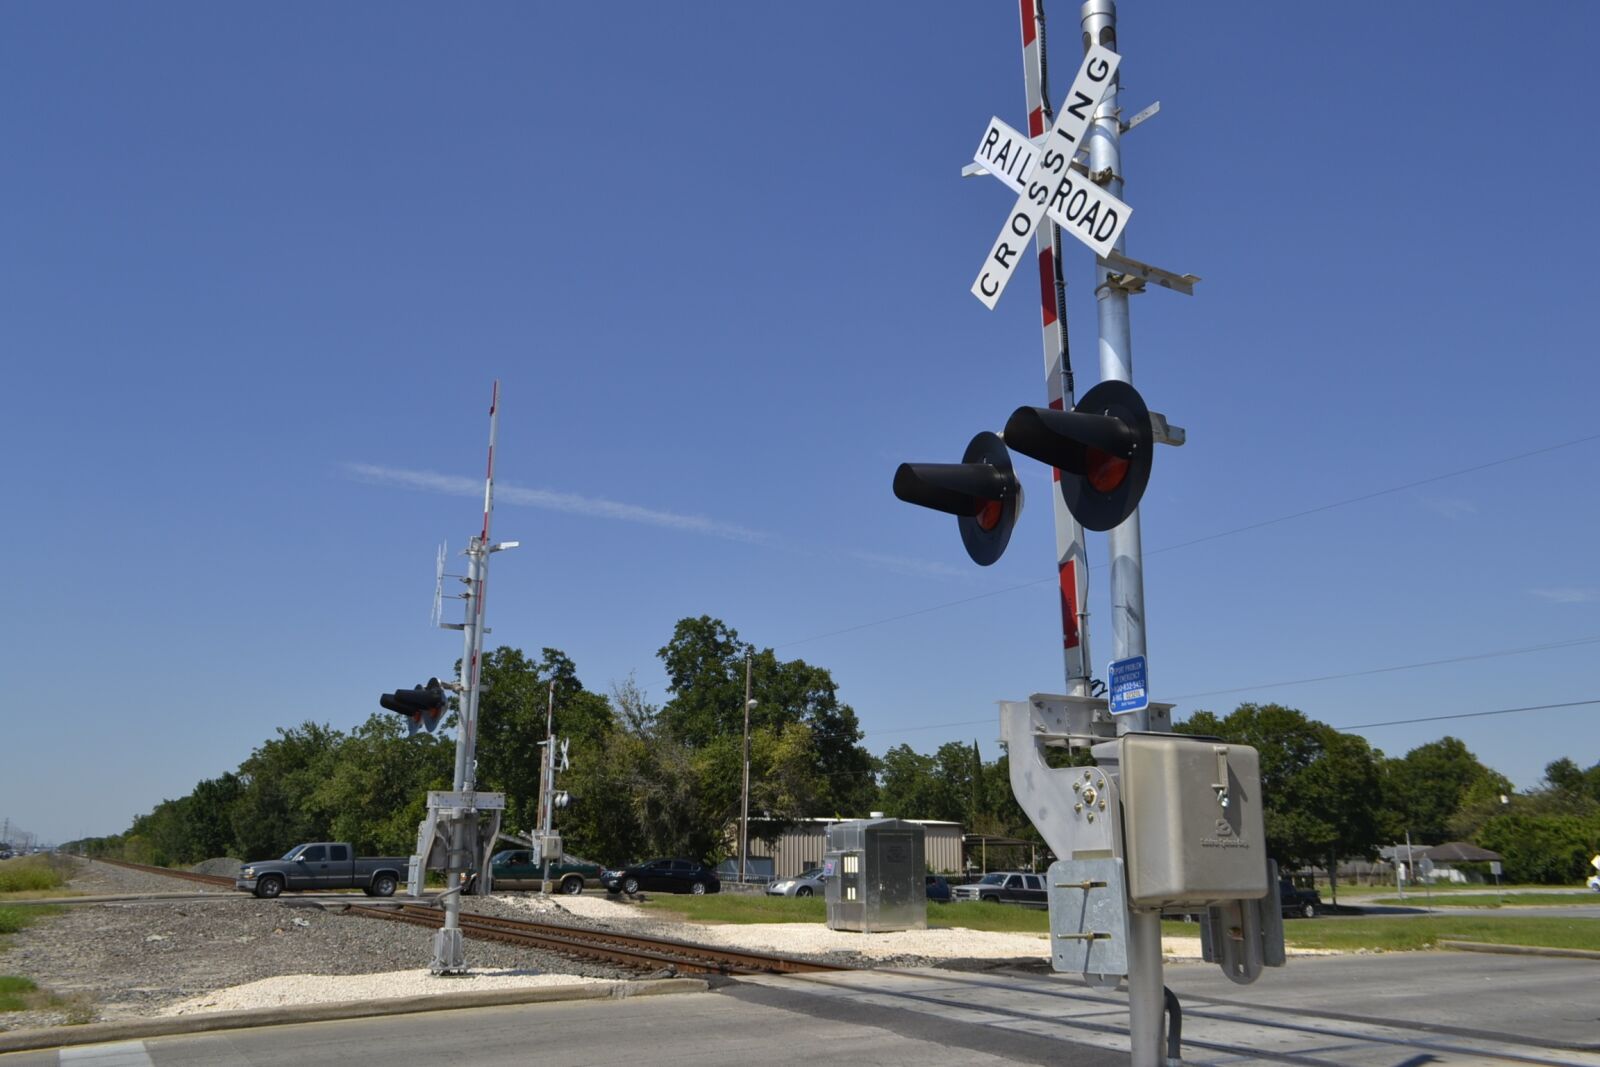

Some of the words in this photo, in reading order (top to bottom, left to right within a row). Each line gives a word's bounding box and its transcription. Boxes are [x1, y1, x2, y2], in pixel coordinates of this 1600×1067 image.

[980, 57, 1109, 298] CROSSING
[980, 127, 1032, 187] RAIL
[1050, 177, 1118, 242] ROAD
